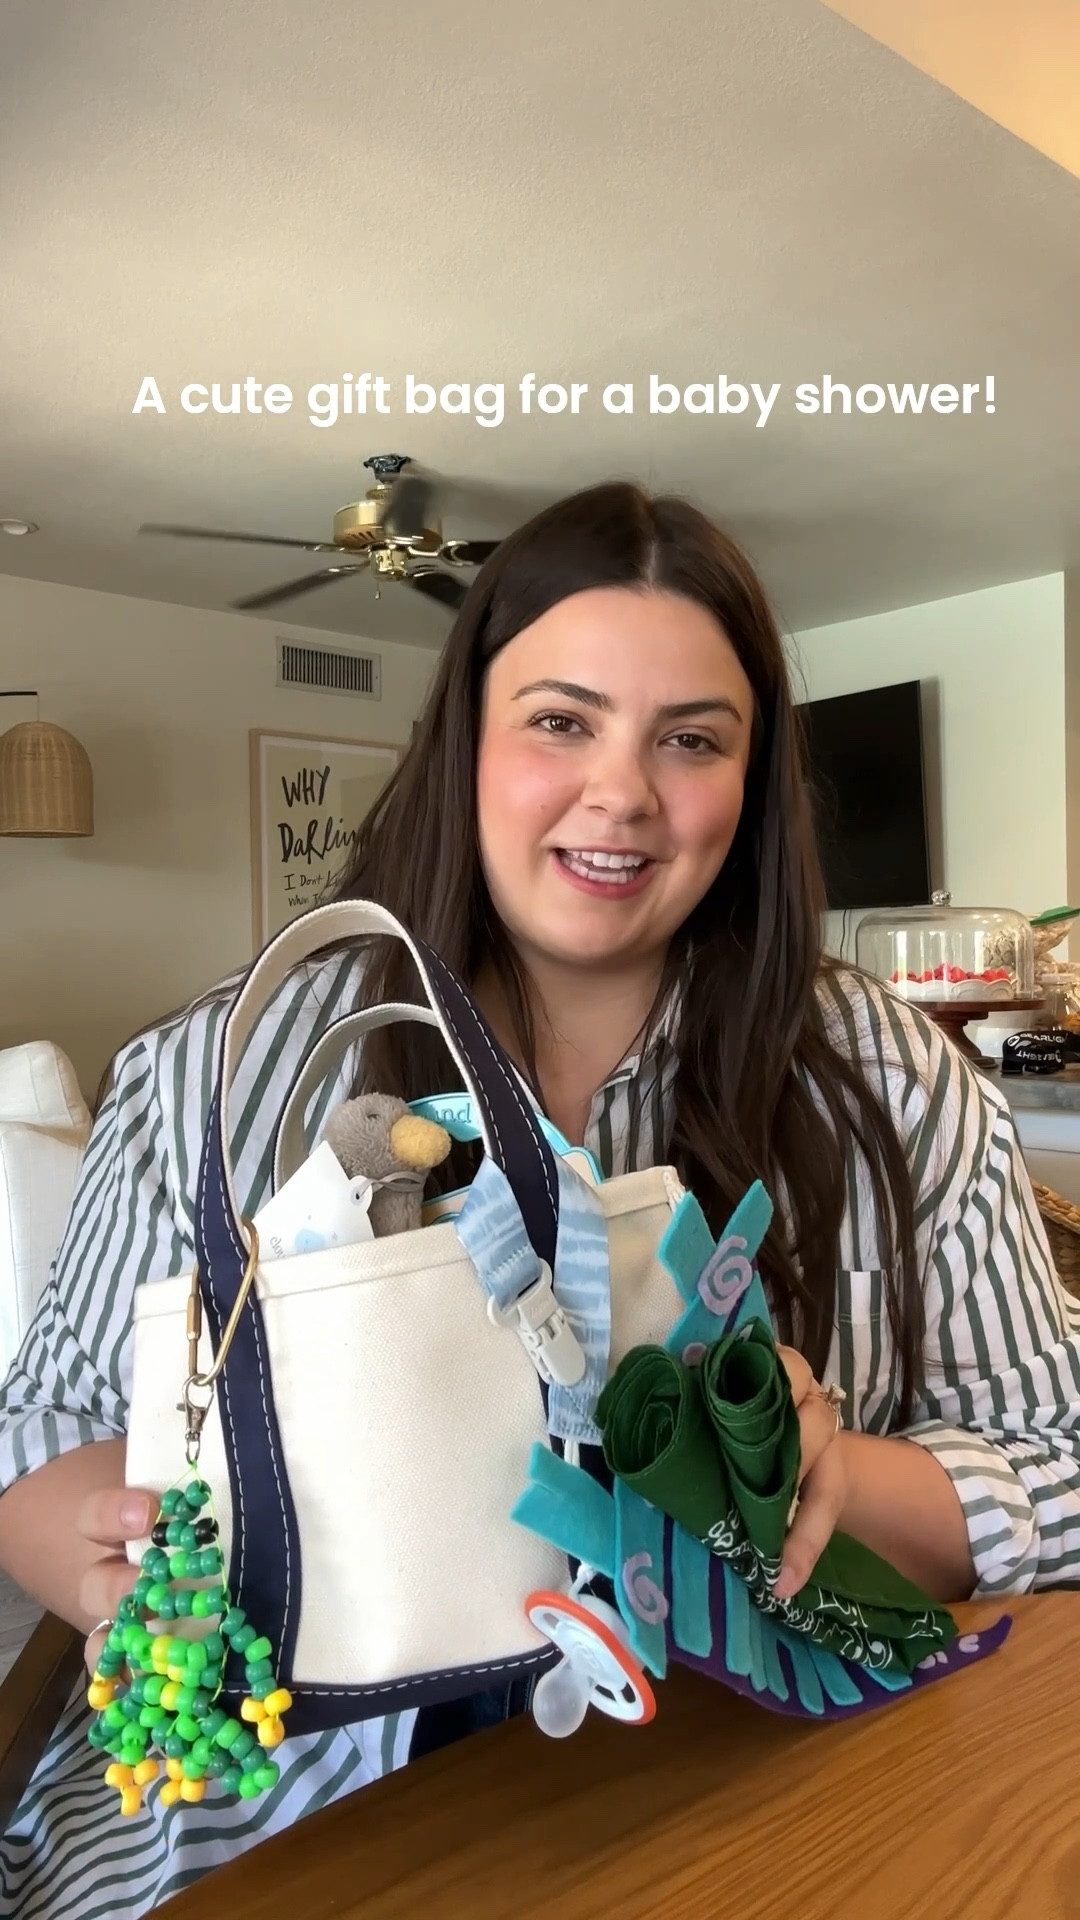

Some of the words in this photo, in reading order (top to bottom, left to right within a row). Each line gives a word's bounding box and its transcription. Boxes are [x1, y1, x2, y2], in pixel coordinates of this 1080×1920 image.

[281, 765, 331, 808] WHY
[277, 815, 357, 865] DaRlin
[283, 873, 297, 891] I
